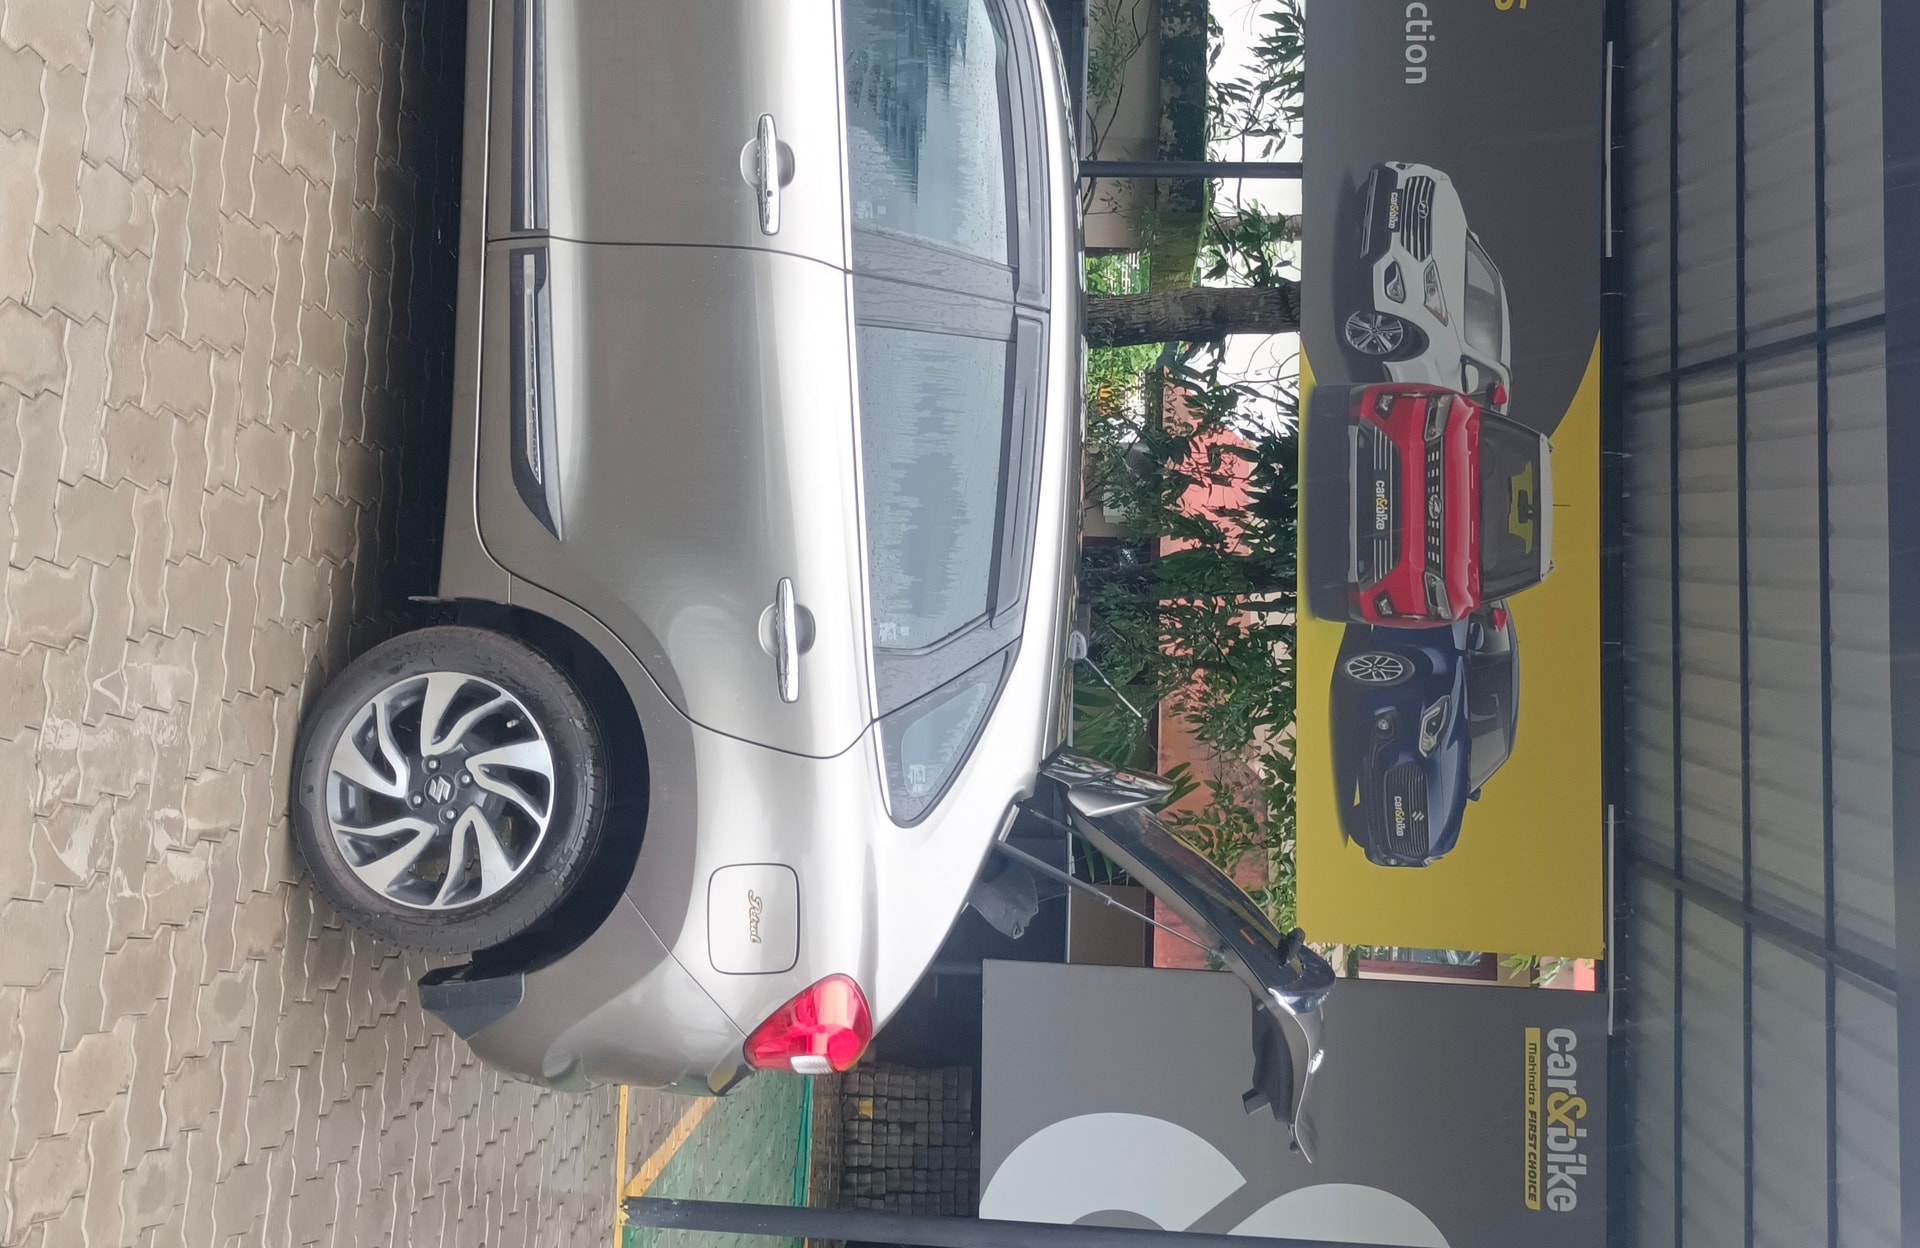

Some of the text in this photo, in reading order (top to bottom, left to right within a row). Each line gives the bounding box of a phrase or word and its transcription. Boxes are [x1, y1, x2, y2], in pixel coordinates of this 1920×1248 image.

[1405, 2, 1435, 85] ction
[1387, 191, 1399, 229] car&bike
[1375, 480, 1388, 530] car&bike
[1393, 795, 1406, 837] car&bike
[748, 890, 763, 944] Petrol
[1528, 1042, 1537, 1202] Mahindra FIRST CHOICE
[1546, 1028, 1588, 1212] car&bike
